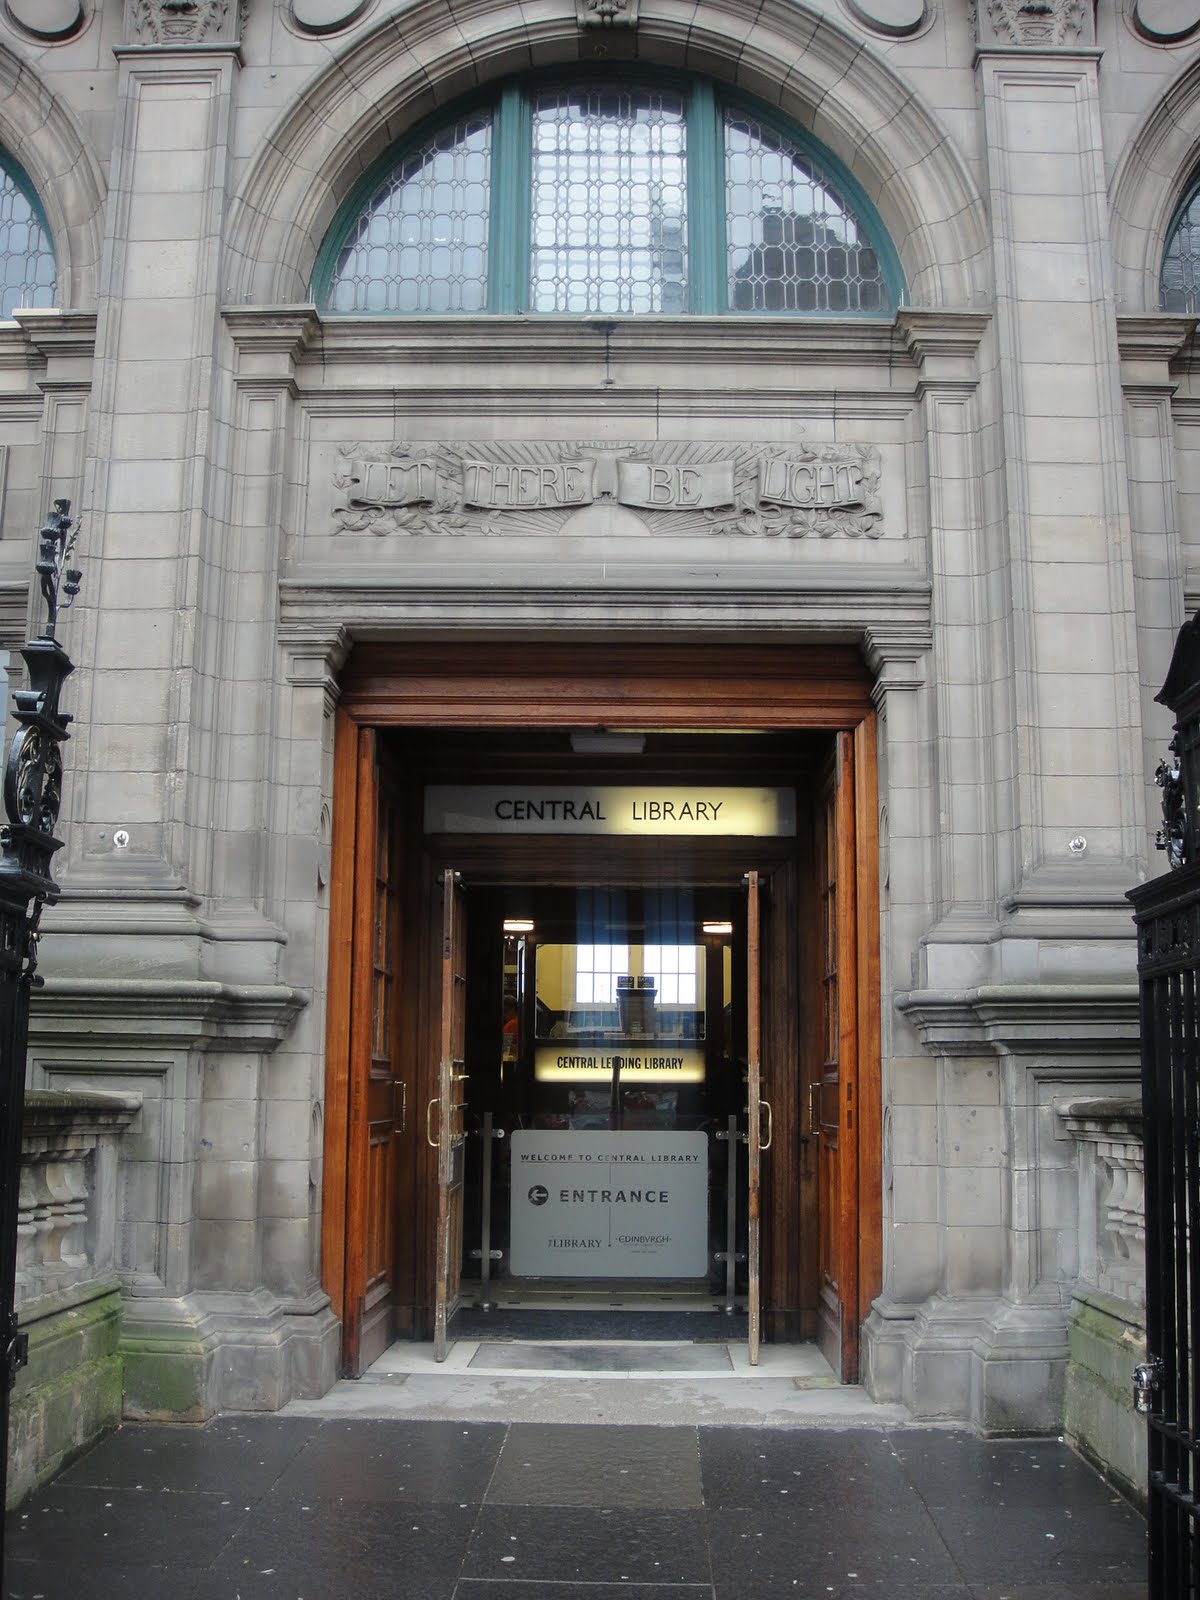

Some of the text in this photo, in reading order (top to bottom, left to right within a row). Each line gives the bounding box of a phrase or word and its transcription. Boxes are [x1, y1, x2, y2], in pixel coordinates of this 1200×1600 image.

[363, 459, 862, 507] LET THERE BE LIGHT
[495, 799, 724, 821] CENTRAL LIBRARY
[557, 1056, 599, 1069] CENTRAL
[644, 1057, 684, 1070] LIBRARY
[597, 1154, 646, 1162] CENTRAL
[651, 1154, 699, 1162] LIBRARY
[559, 1189, 669, 1203] ENTRANCE
[553, 1239, 602, 1248] LIBRARY
